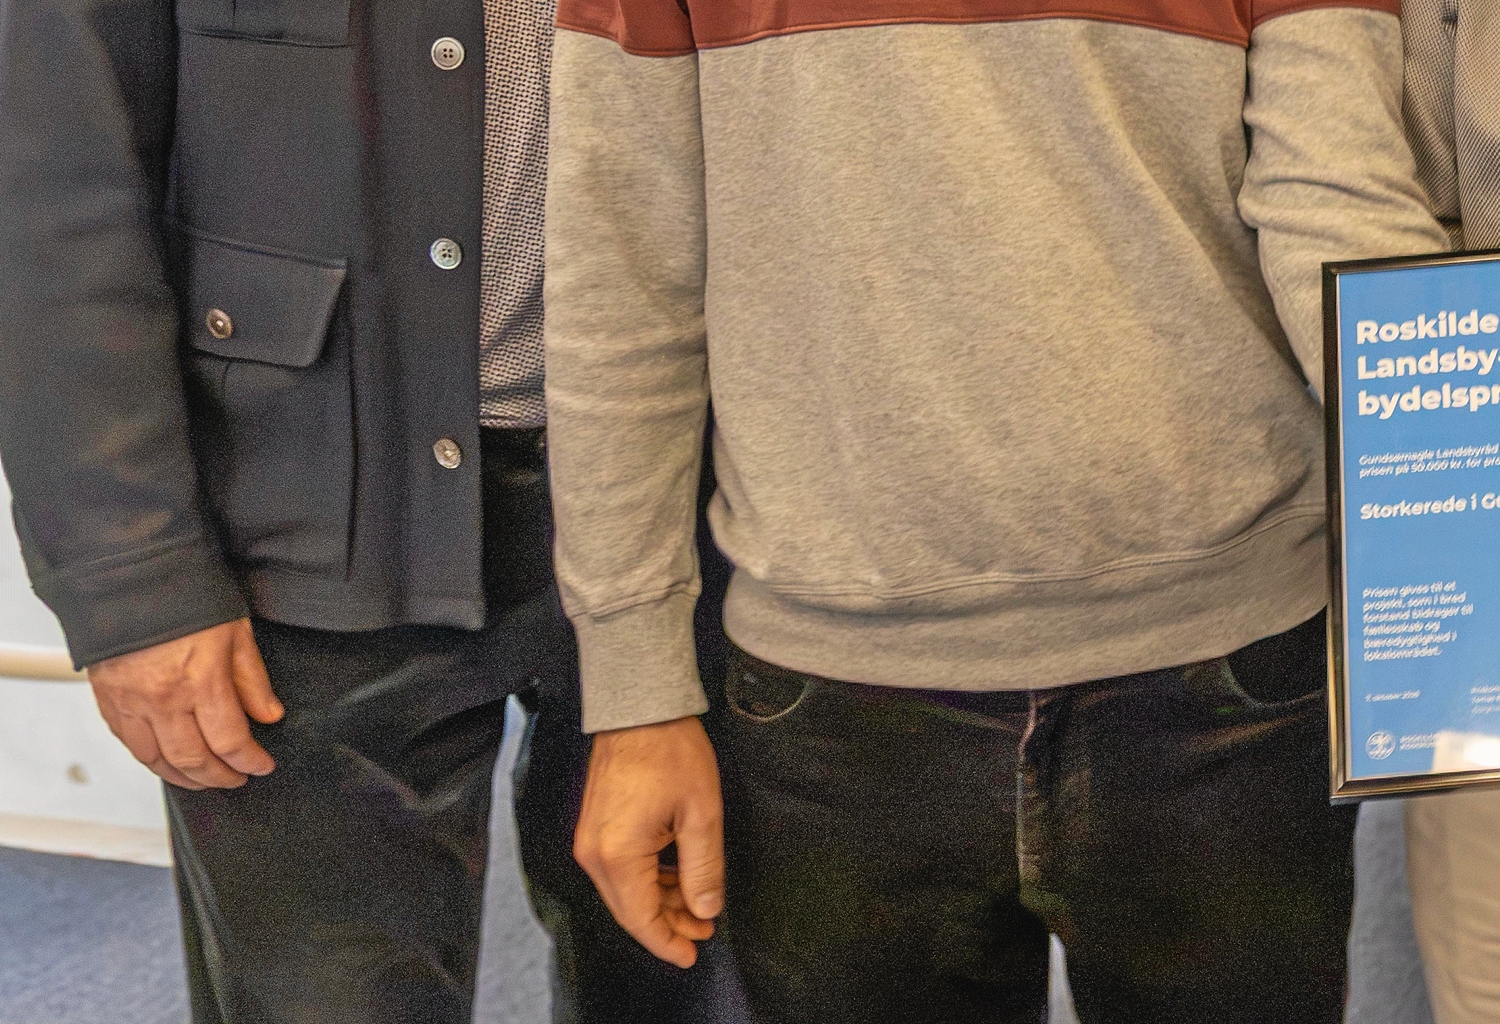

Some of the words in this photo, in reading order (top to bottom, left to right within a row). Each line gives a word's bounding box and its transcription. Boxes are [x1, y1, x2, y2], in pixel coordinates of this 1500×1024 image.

[1357, 309, 1499, 344] Roskilde
[1360, 464, 1393, 479] prisen
[1395, 463, 1409, 476] på
[1465, 458, 1481, 469] for
[1360, 494, 1467, 520] Storkerede
[1470, 492, 1477, 511] i
